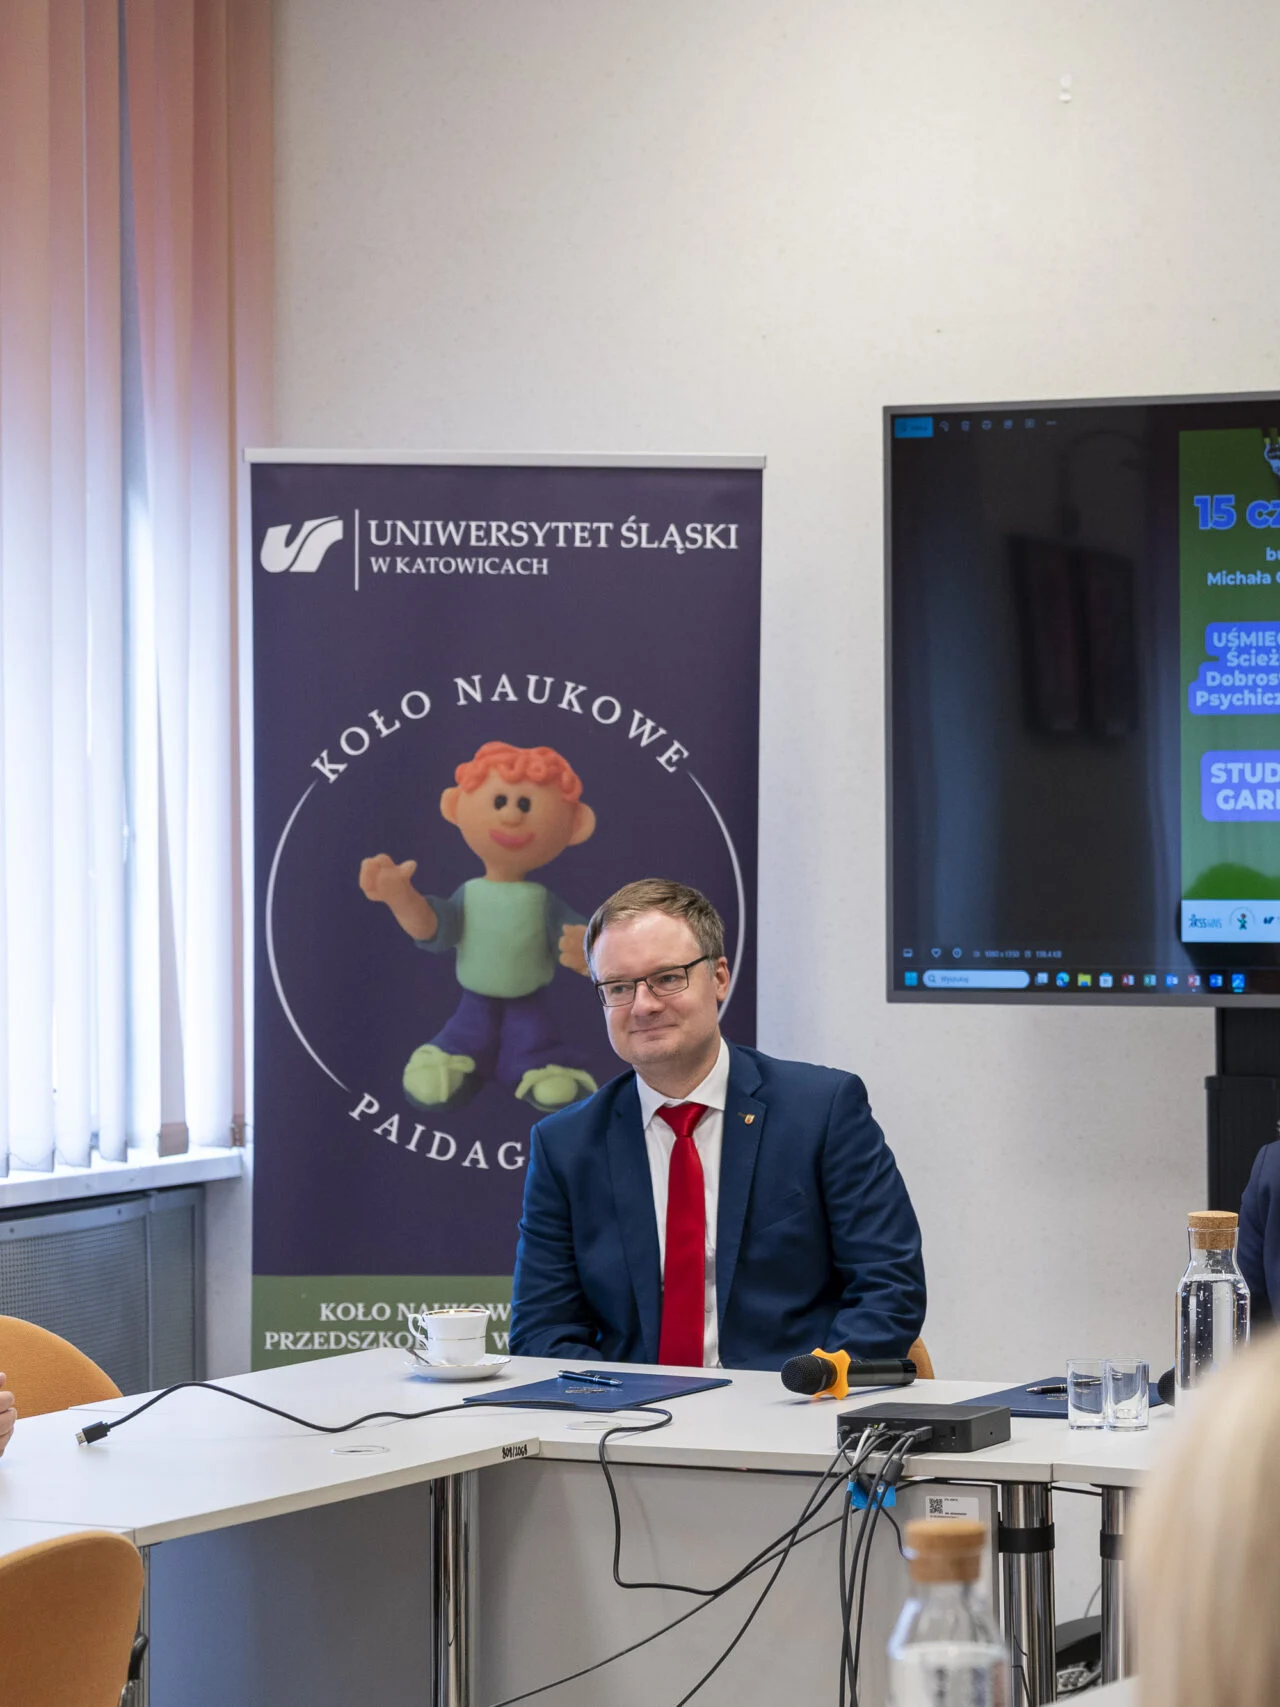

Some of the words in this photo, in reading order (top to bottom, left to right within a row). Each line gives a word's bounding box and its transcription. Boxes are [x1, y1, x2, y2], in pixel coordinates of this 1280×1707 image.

[1193, 494, 1237, 530] 15
[367, 519, 615, 548] UNIWERSYTET
[620, 515, 740, 556] ŚLĄSKI
[370, 556, 393, 575] W
[395, 556, 549, 576] KATOWICACH
[1207, 569, 1271, 586] Michała
[311, 690, 432, 783] KOŁO
[454, 674, 690, 773] NAUKOWE
[348, 1092, 526, 1170] PAIDAG
[319, 1302, 391, 1322] KOŁO
